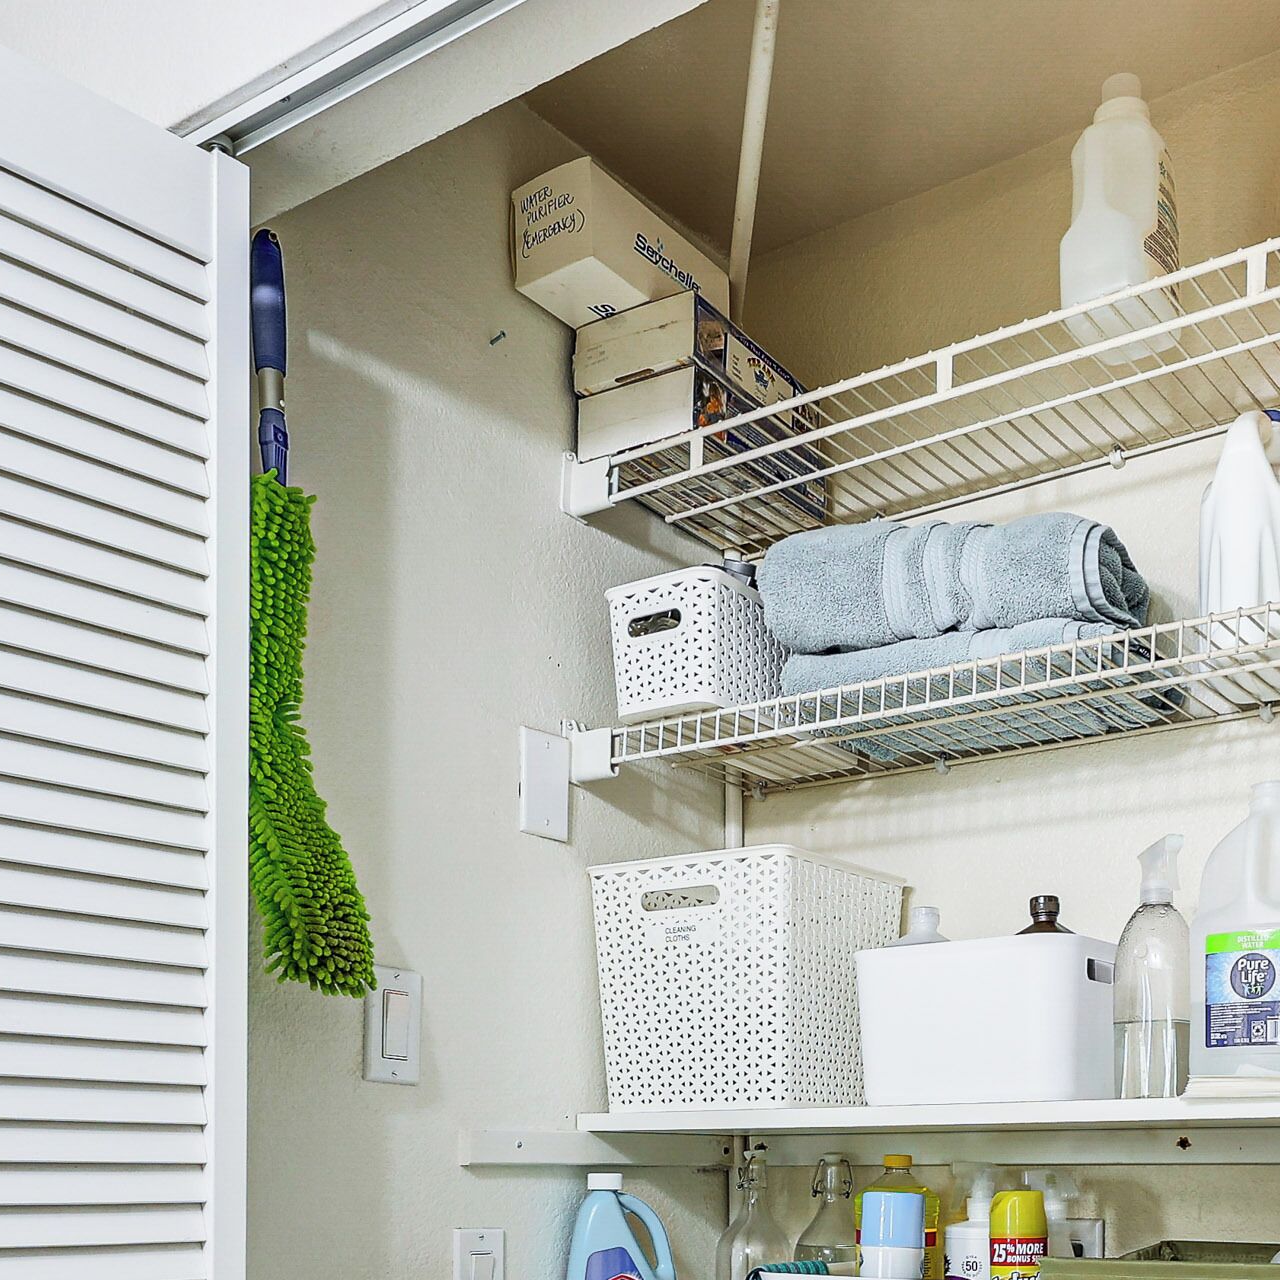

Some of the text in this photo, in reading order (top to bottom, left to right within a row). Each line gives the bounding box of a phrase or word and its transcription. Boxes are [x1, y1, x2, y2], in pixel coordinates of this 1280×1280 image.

[520, 186, 553, 213] WATER
[527, 193, 575, 226] PURIFIER
[634, 232, 701, 293] Seychelle
[665, 925, 696, 935] CLEANING
[665, 934, 690, 943] CLOTHS
[1237, 958, 1269, 971] Pure
[1241, 970, 1265, 986] Life
[992, 1243, 1044, 1263] 25% MORE
[1007, 1255, 1030, 1263] BONUS
[965, 1260, 978, 1272] 50
